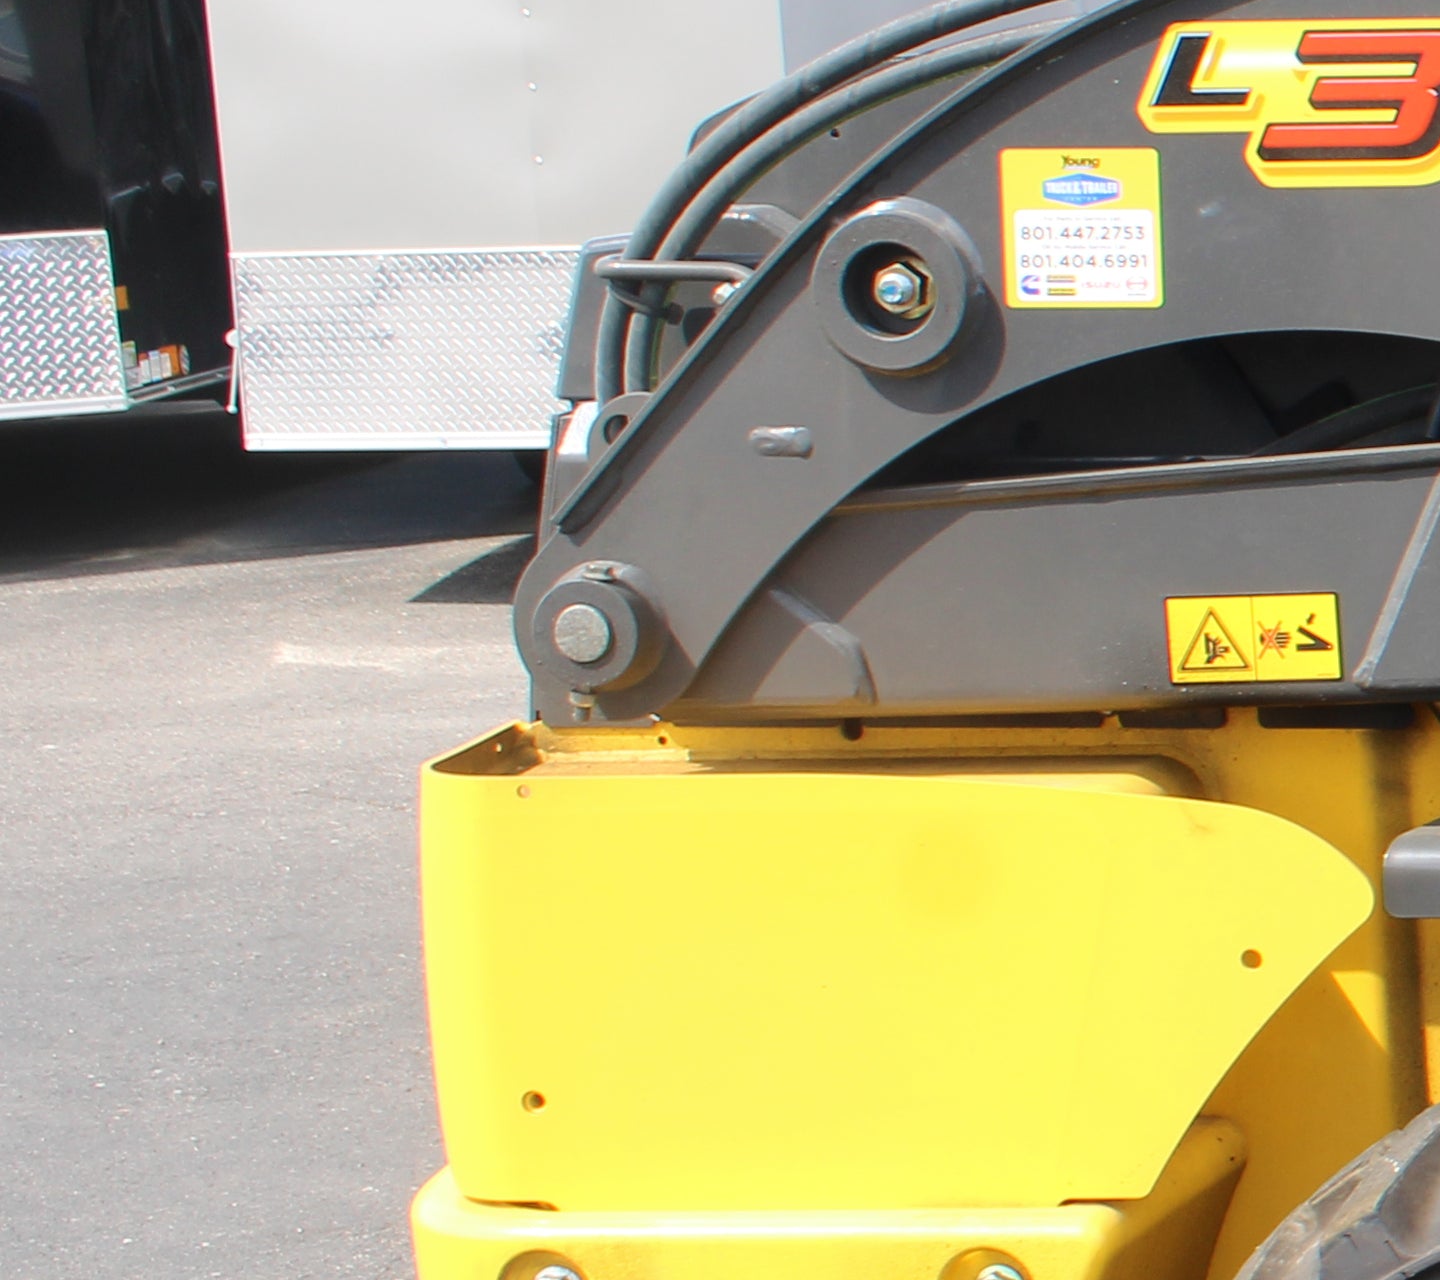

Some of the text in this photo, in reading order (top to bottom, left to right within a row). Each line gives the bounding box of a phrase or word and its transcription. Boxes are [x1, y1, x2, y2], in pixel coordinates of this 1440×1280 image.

[1061, 155, 1100, 168] Young
[1020, 226, 1145, 240] 801.447.2753
[1020, 254, 1148, 269] 801.404.6991
